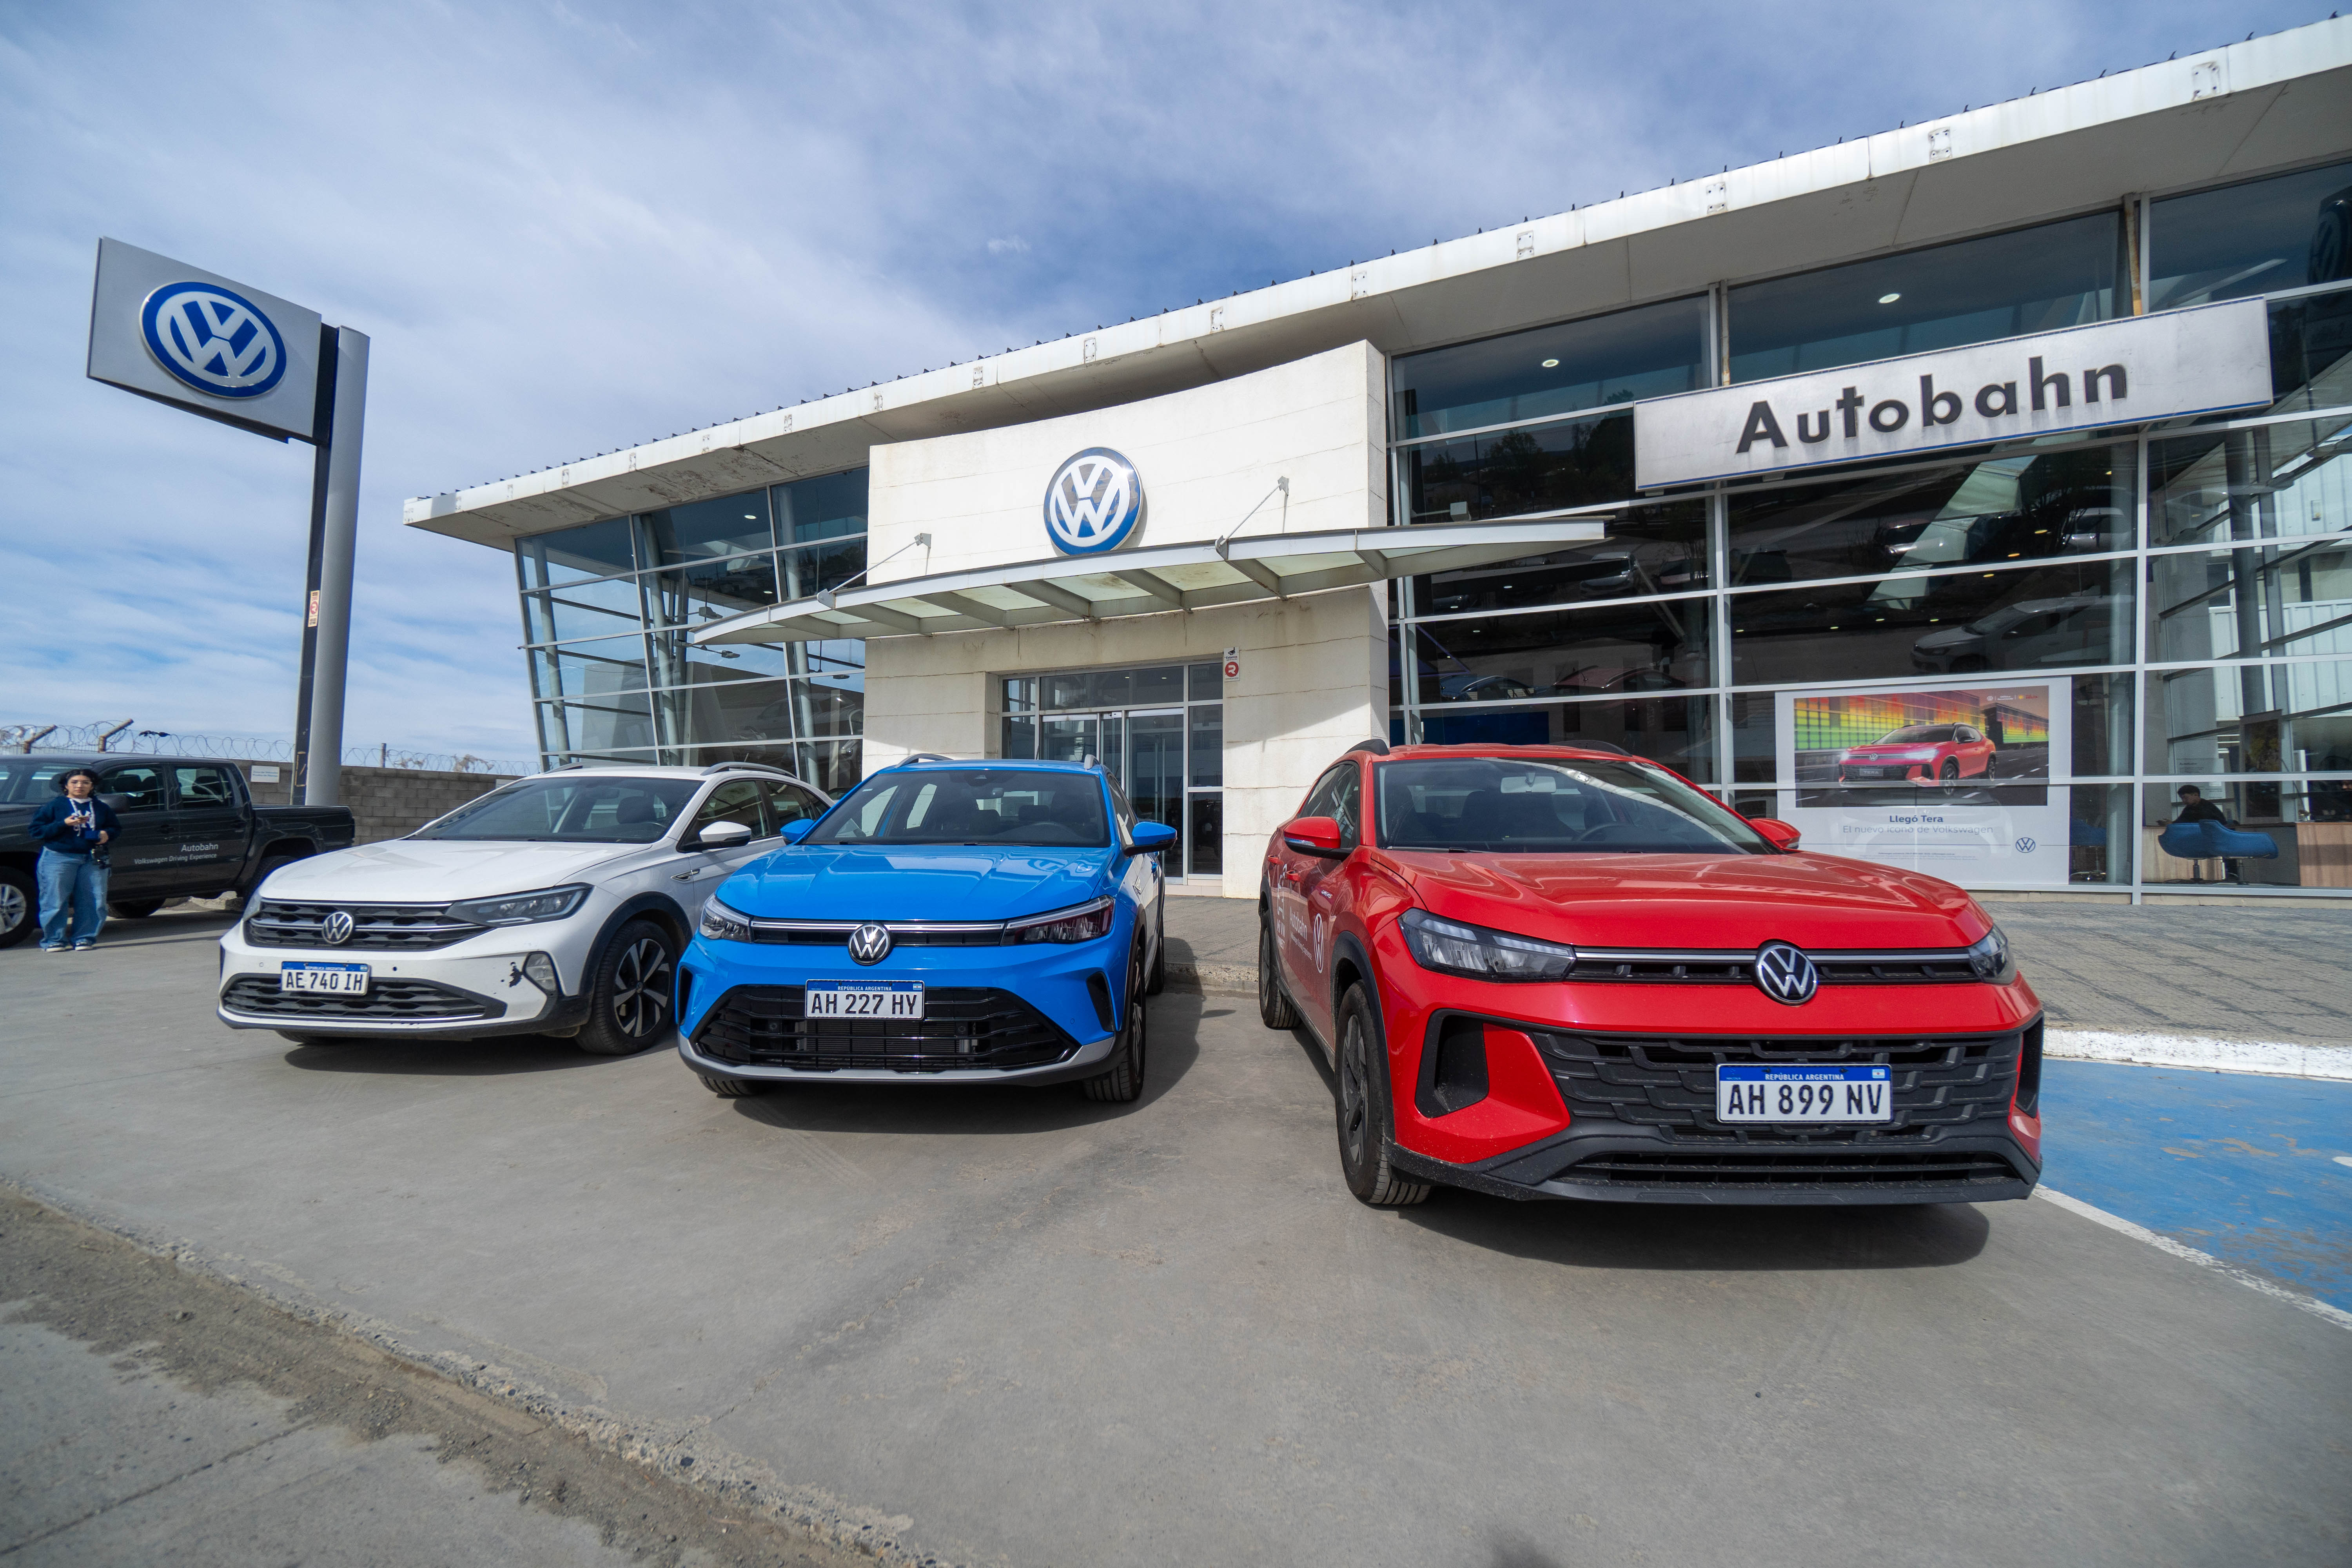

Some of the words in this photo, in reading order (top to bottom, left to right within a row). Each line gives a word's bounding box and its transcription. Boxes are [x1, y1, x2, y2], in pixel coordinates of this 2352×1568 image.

[156, 291, 276, 388] VW
[1736, 356, 2127, 453] Autobahn
[1049, 456, 1130, 547] VW
[1889, 815, 1918, 824] Llegó
[1933, 826, 1993, 835] Volkswagen
[181, 843, 218, 852] Autobahn
[2016, 837, 2035, 852] VW
[323, 912, 352, 942] VW
[1290, 906, 1307, 941] Autobahn
[851, 925, 888, 961] VW
[286, 972, 305, 988] AE
[310, 973, 338, 989] 740
[344, 973, 363, 991] IH
[1759, 946, 1814, 999] VW
[811, 993, 837, 1013] AH
[845, 994, 884, 1014] 227
[892, 994, 917, 1014] HY
[1728, 1084, 1765, 1114] AH
[1778, 1084, 1834, 1114] 899
[1847, 1084, 1882, 1114] NV
